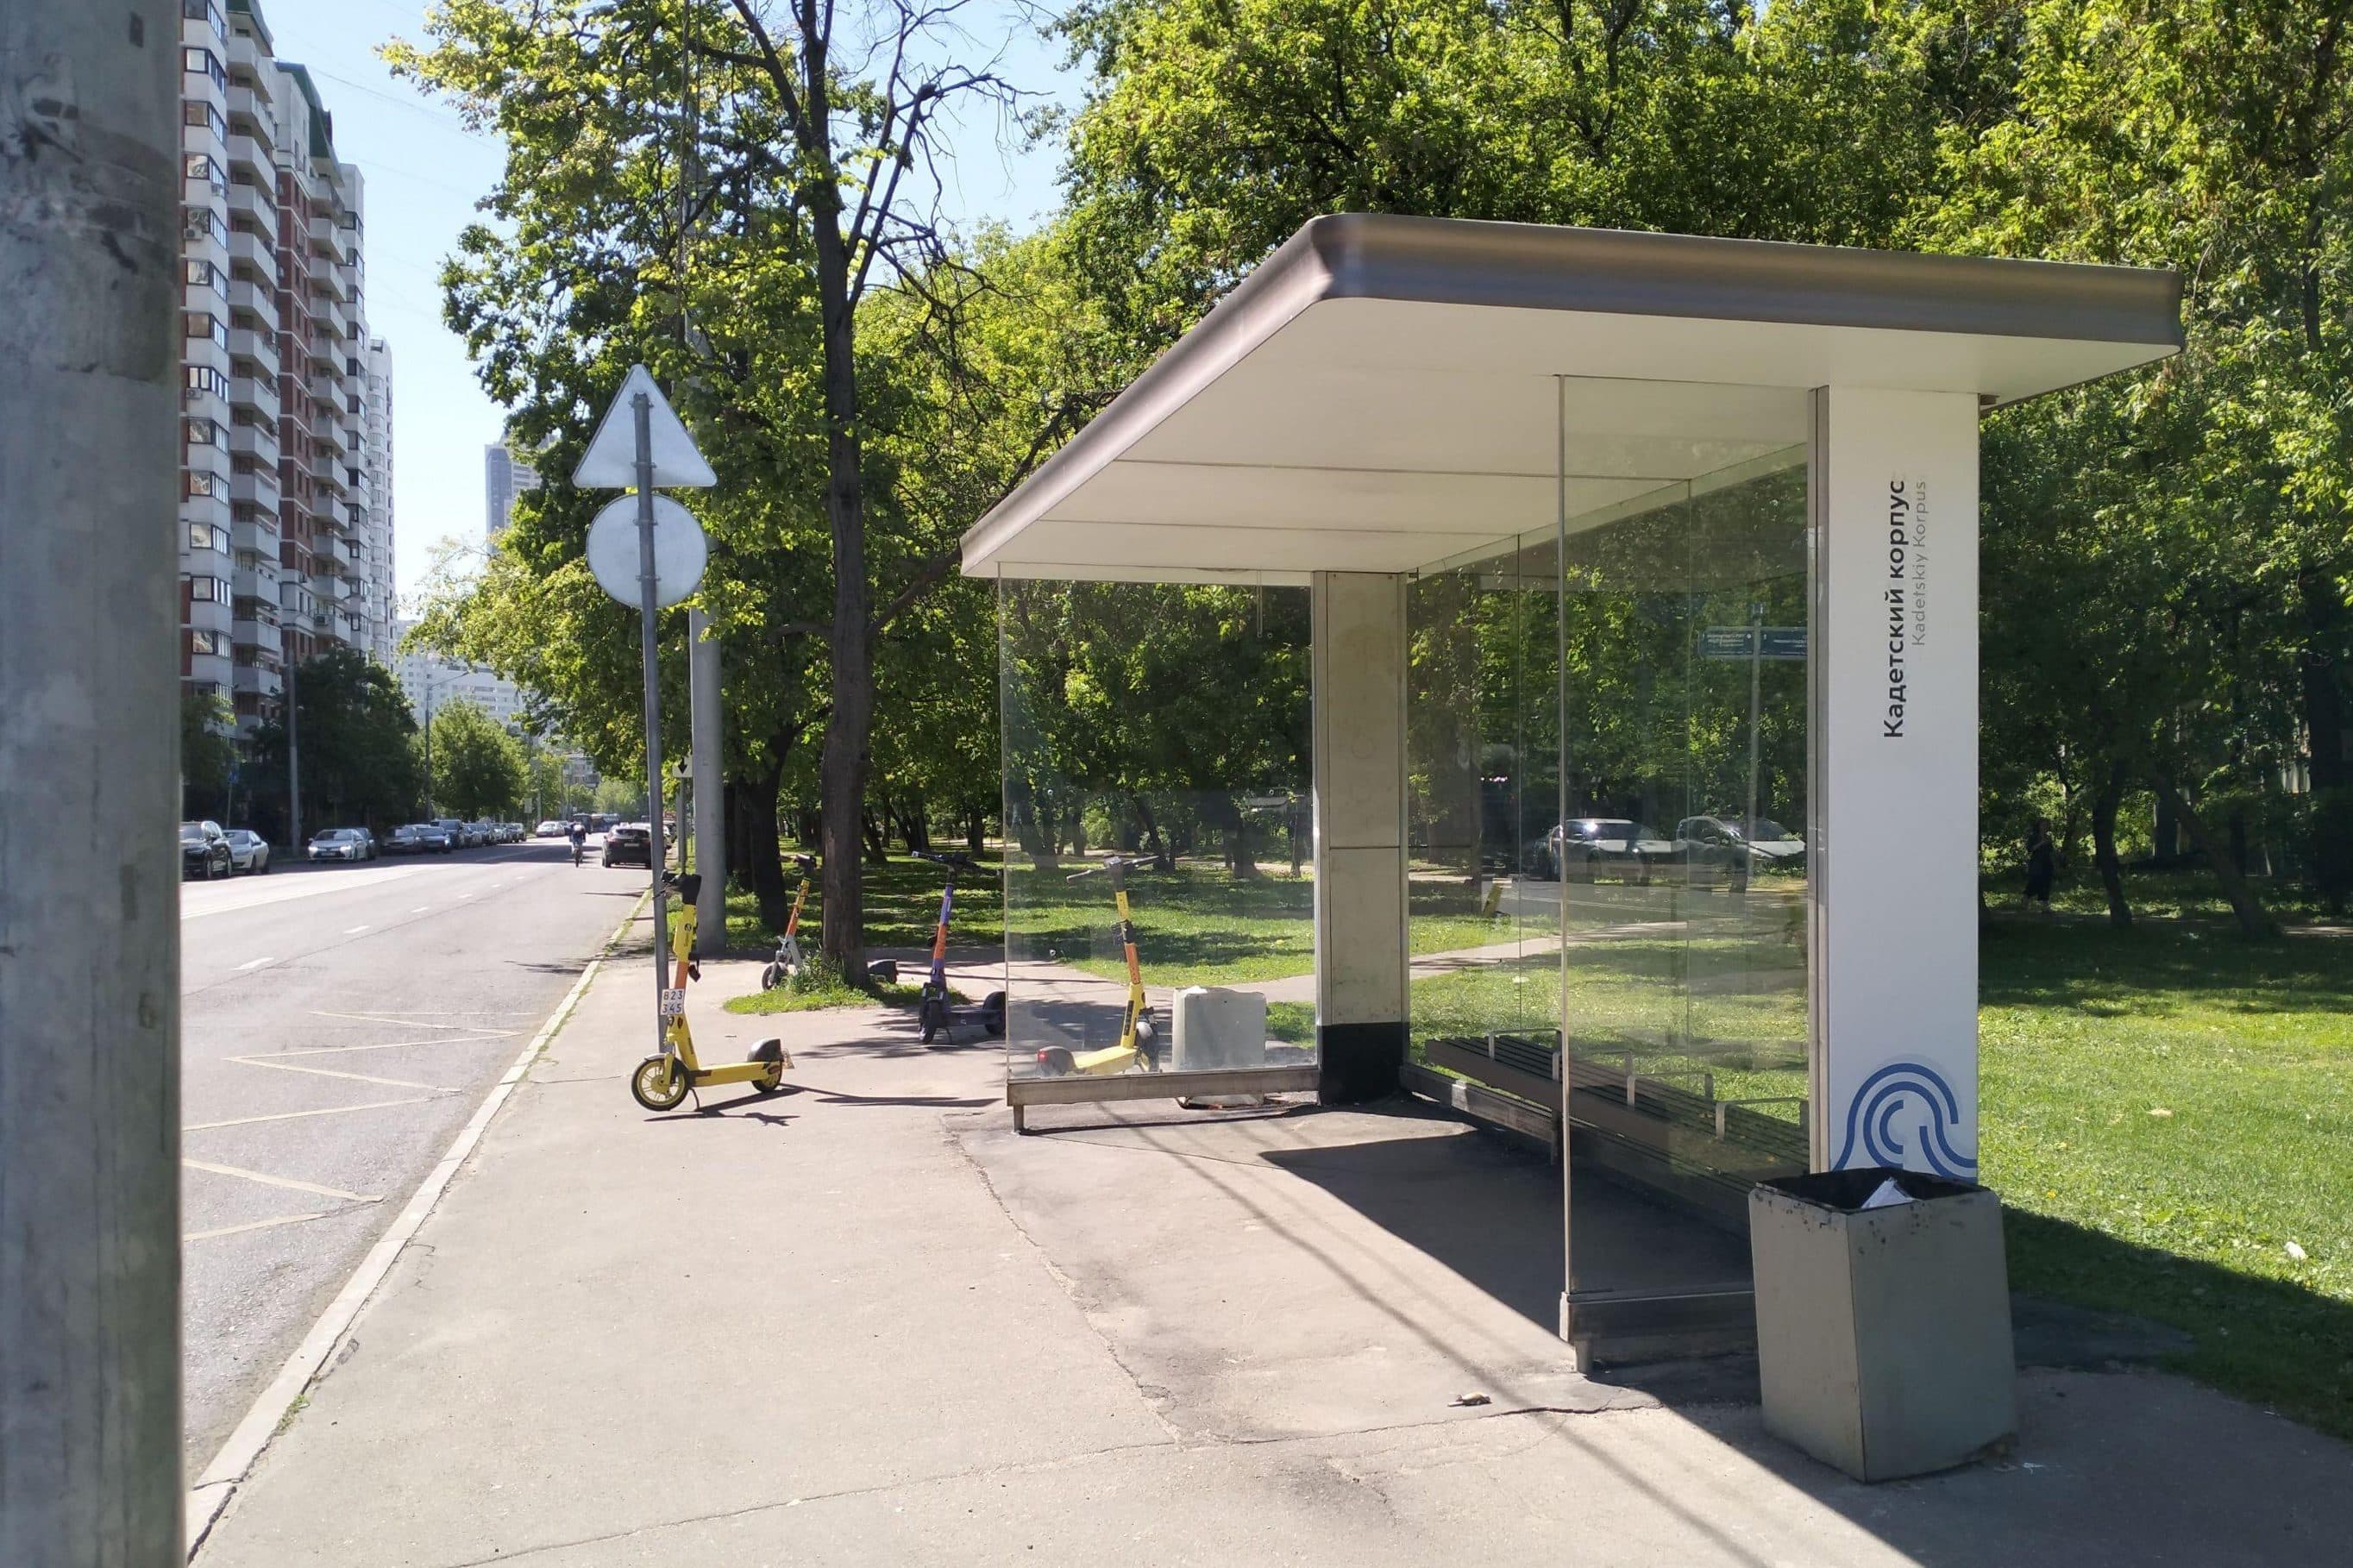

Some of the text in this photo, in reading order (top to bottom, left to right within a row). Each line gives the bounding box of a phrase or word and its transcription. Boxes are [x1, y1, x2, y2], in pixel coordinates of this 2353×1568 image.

[1911, 480, 1929, 646] Kadetskiy Korpus
[1883, 480, 1910, 737] Кадетский корпус
[662, 1003, 681, 1013] 345
[663, 990, 683, 1000] 823
